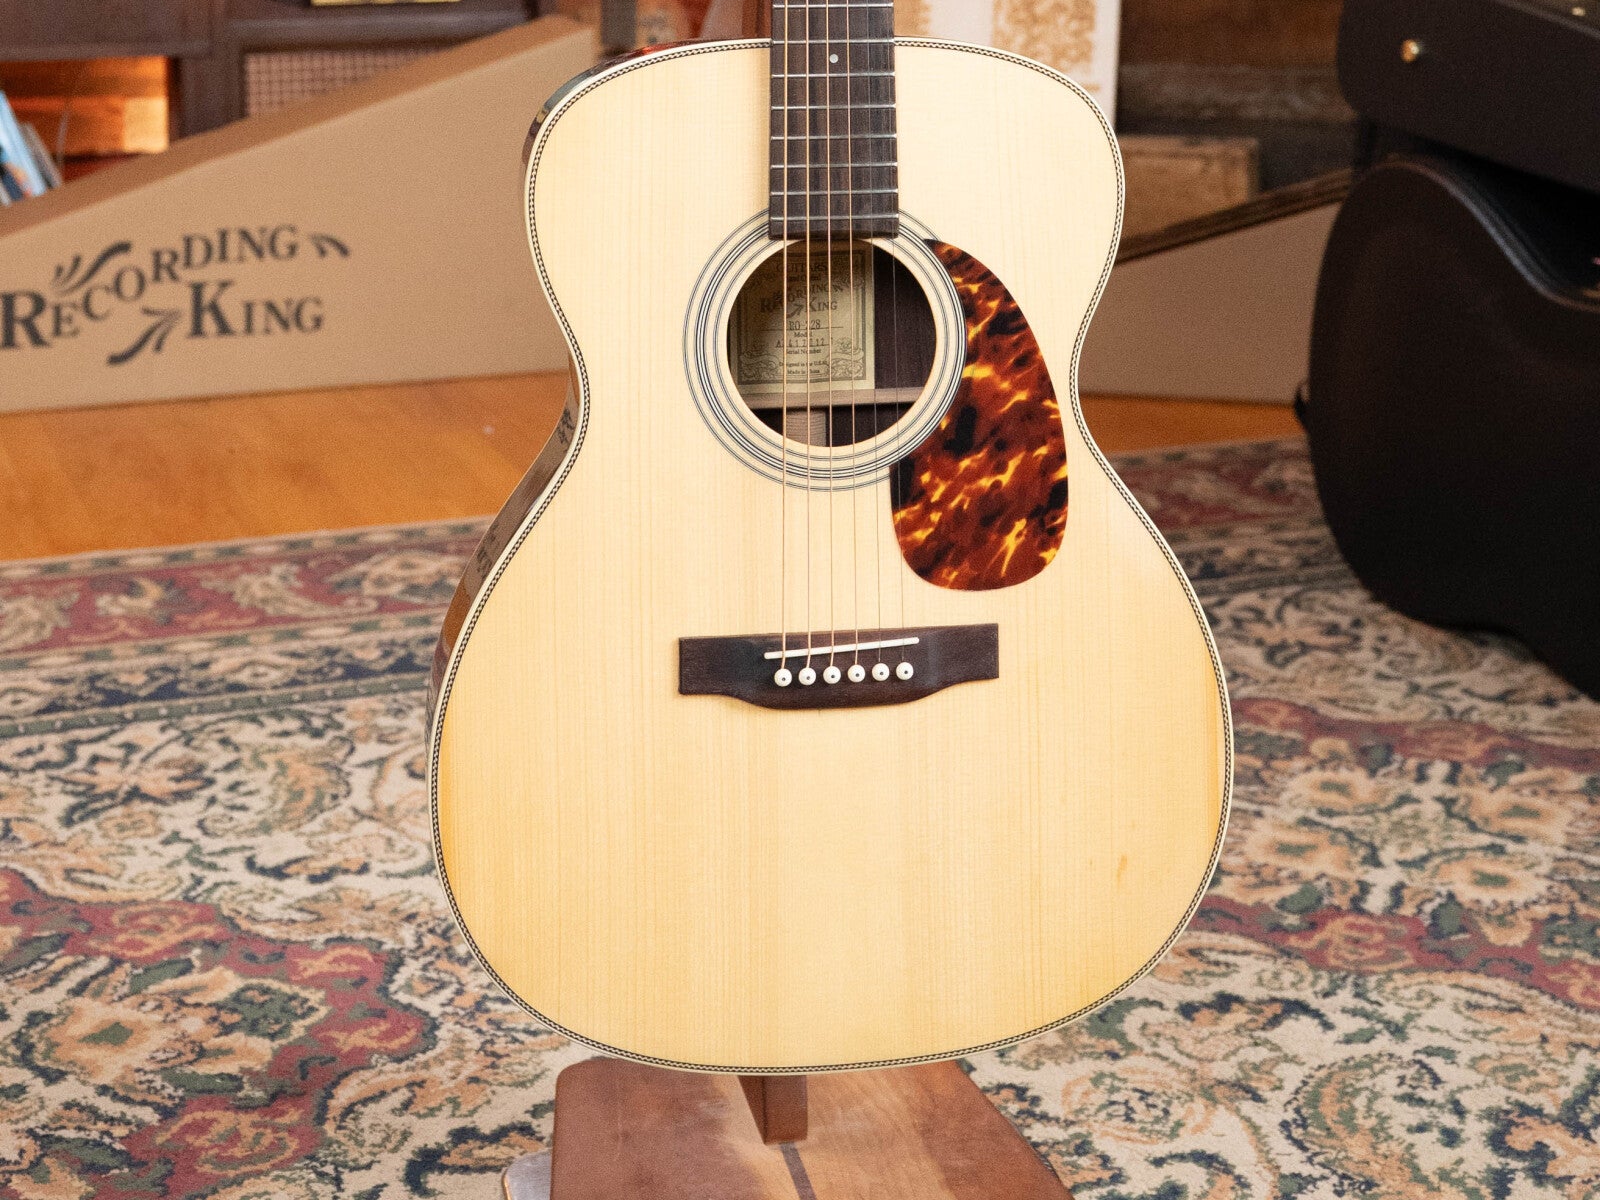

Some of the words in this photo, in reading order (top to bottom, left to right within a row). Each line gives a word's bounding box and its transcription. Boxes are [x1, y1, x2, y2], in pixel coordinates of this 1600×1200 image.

[0, 224, 300, 350] RECORDING
[185, 278, 325, 338] KING
[760, 284, 831, 312] REORING
